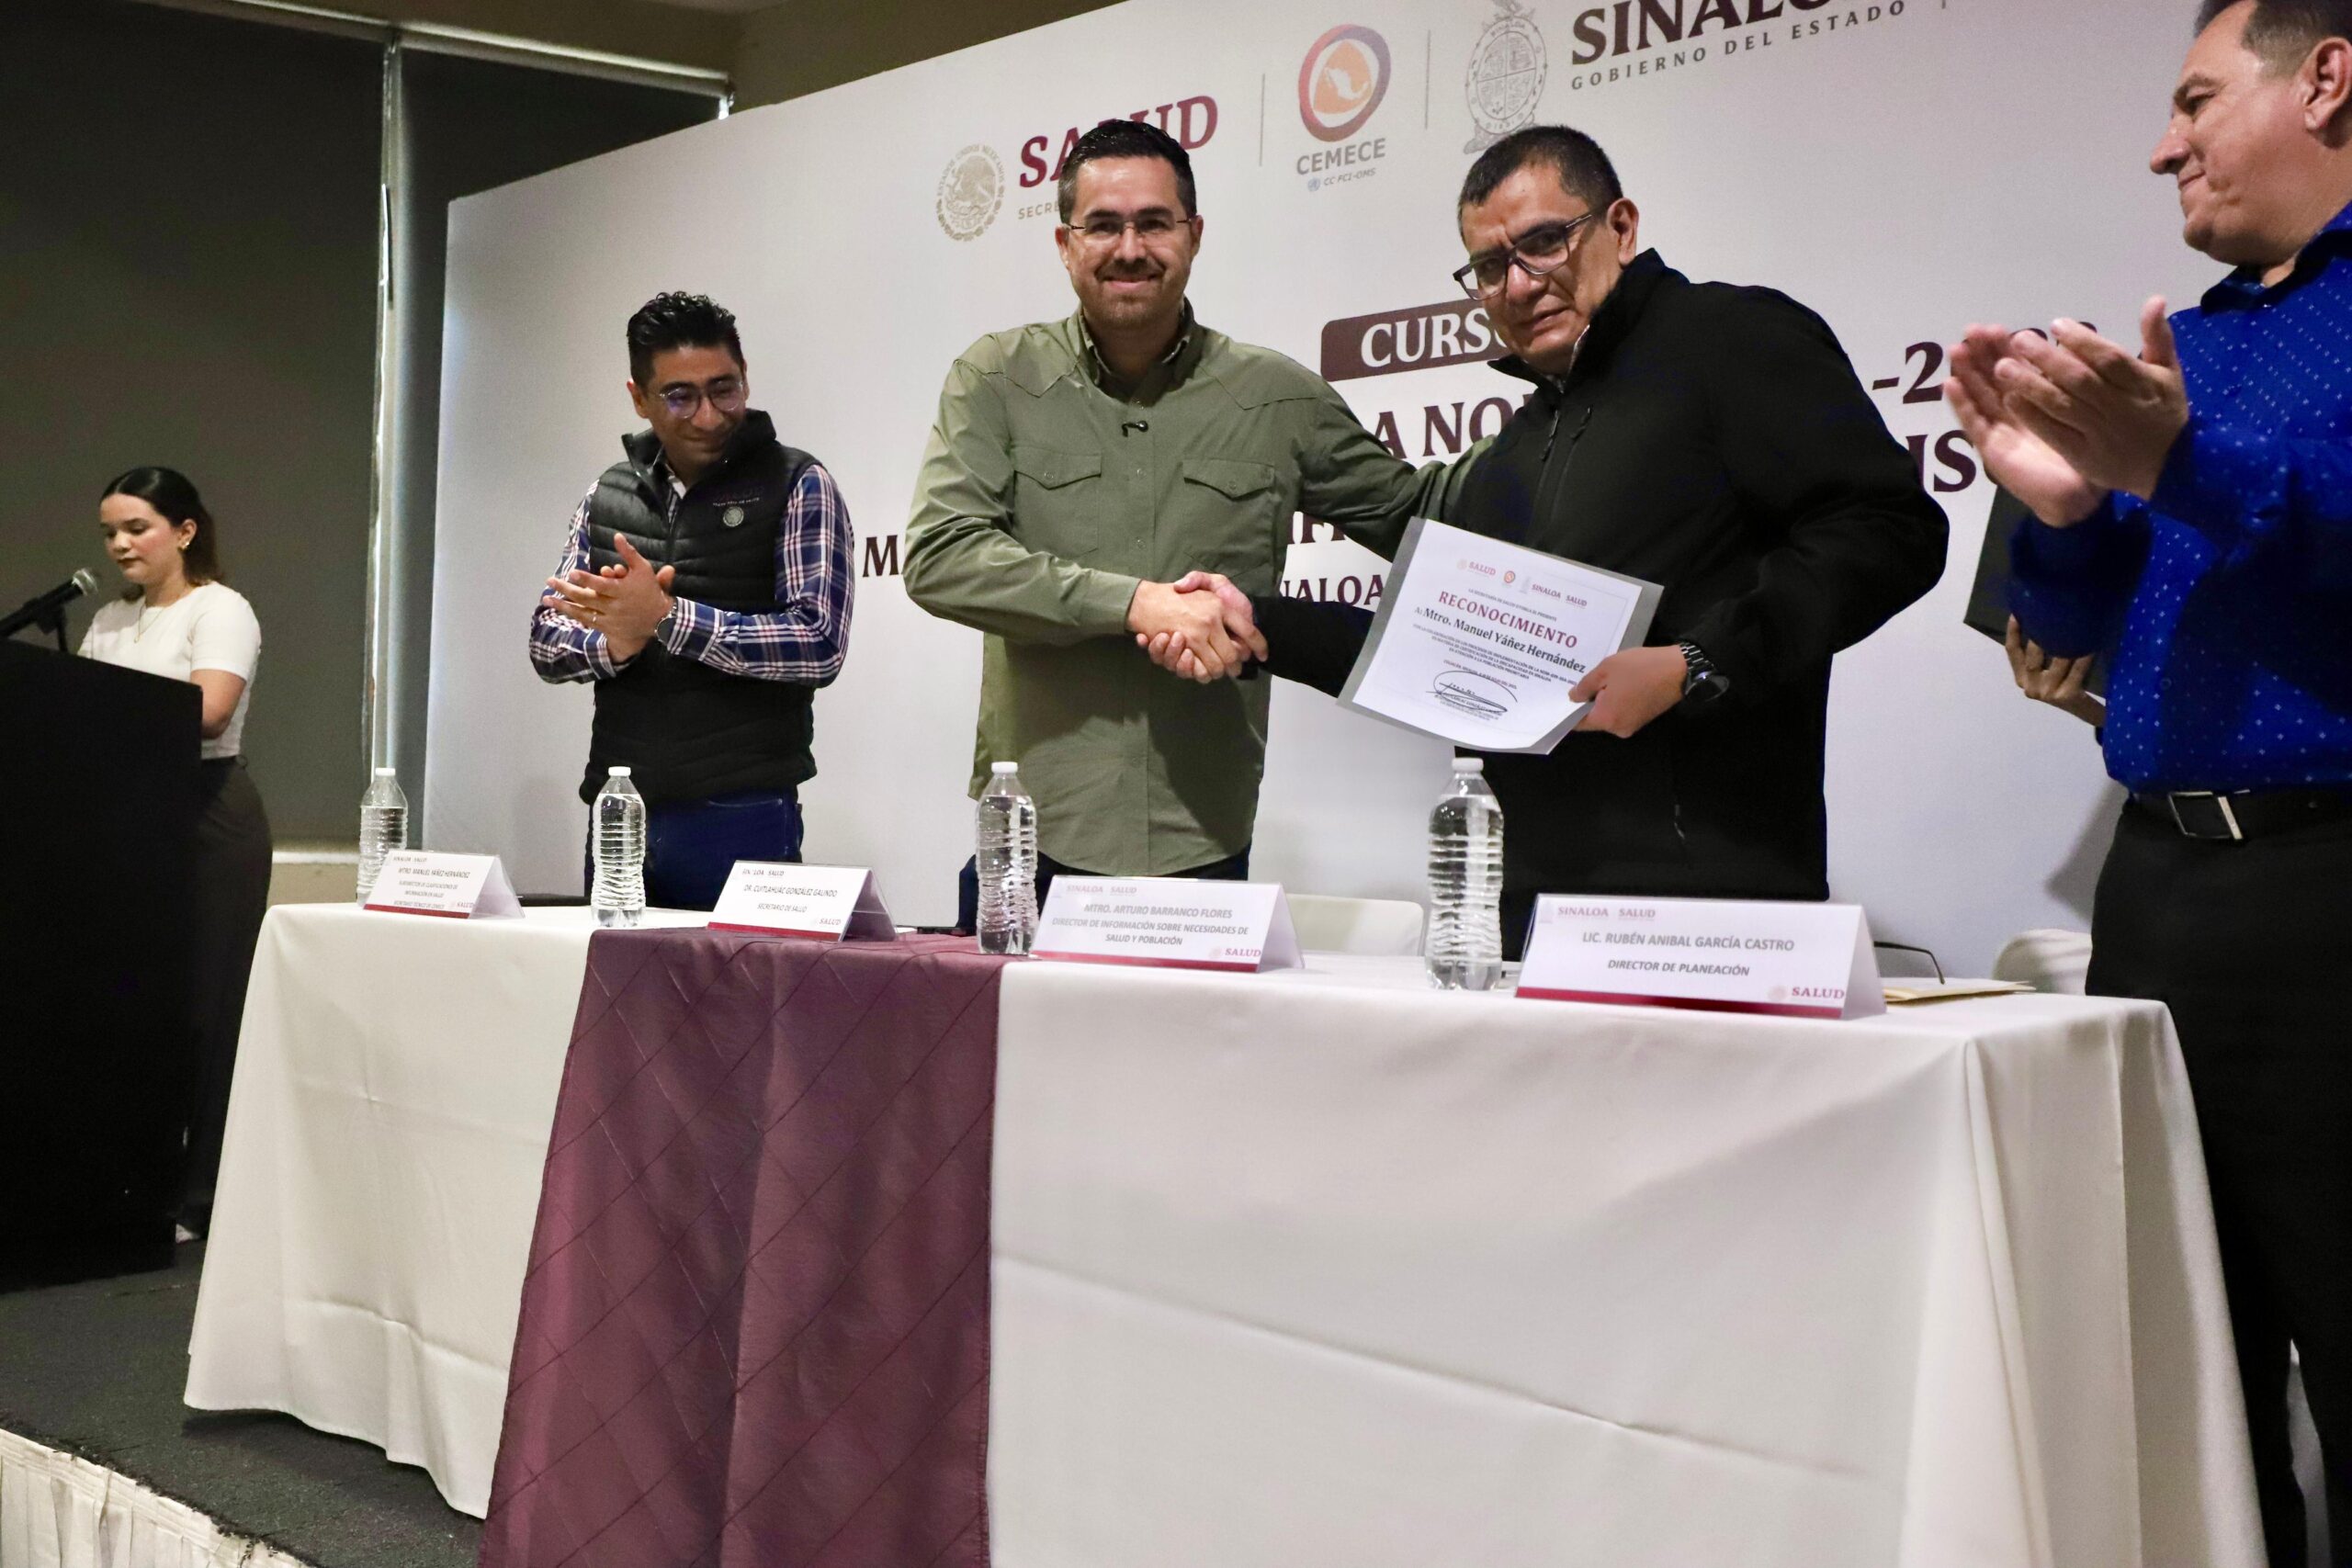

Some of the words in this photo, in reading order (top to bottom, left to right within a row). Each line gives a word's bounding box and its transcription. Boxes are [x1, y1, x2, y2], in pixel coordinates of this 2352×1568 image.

[1571, 47, 1707, 90] GOBIERNO
[1724, 32, 1772, 55] DEL
[1792, 0, 1905, 40] ESTADO
[1296, 137, 1385, 175] CEMECE
[1532, 583, 1561, 599] SINALOA
[1439, 591, 1578, 649] RECONOCIMIENTO
[1424, 607, 1452, 626] Mtro.
[1454, 618, 1494, 641] Manuel
[1495, 633, 1525, 653] Yáñez
[1527, 643, 1587, 674] Hernández
[1084, 904, 1112, 913] MTRO.
[1114, 905, 1149, 915] ARTURO
[1149, 906, 1199, 918] BARRANCO
[1200, 908, 1233, 919] FLORES
[1558, 907, 1609, 917] SINALOA
[1619, 908, 1656, 918] SALUD
[1052, 918, 1089, 927] DIRECTOR
[1090, 919, 1100, 928] DE
[1100, 919, 1155, 931] INFORMACIÓN
[1156, 922, 1182, 932] SOBRE
[1183, 924, 1237, 935] NECESIDADES
[1238, 926, 1250, 935] DE
[1105, 933, 1131, 942] SALUD
[1138, 934, 1182, 945] POBLACIÓN
[1582, 931, 1601, 943] LIC.
[1605, 931, 1645, 945] RUBÉN
[1647, 934, 1691, 947] ANIBAL
[1694, 935, 1741, 949] GARCÍA
[1745, 938, 1794, 952] CASTRO
[1225, 948, 1261, 957] SALUD
[1608, 959, 1659, 971] DIRECTOR
[1662, 963, 1676, 972] DE
[1679, 963, 1750, 976] PLANEACIÓN
[1792, 987, 1845, 999] SALUD
